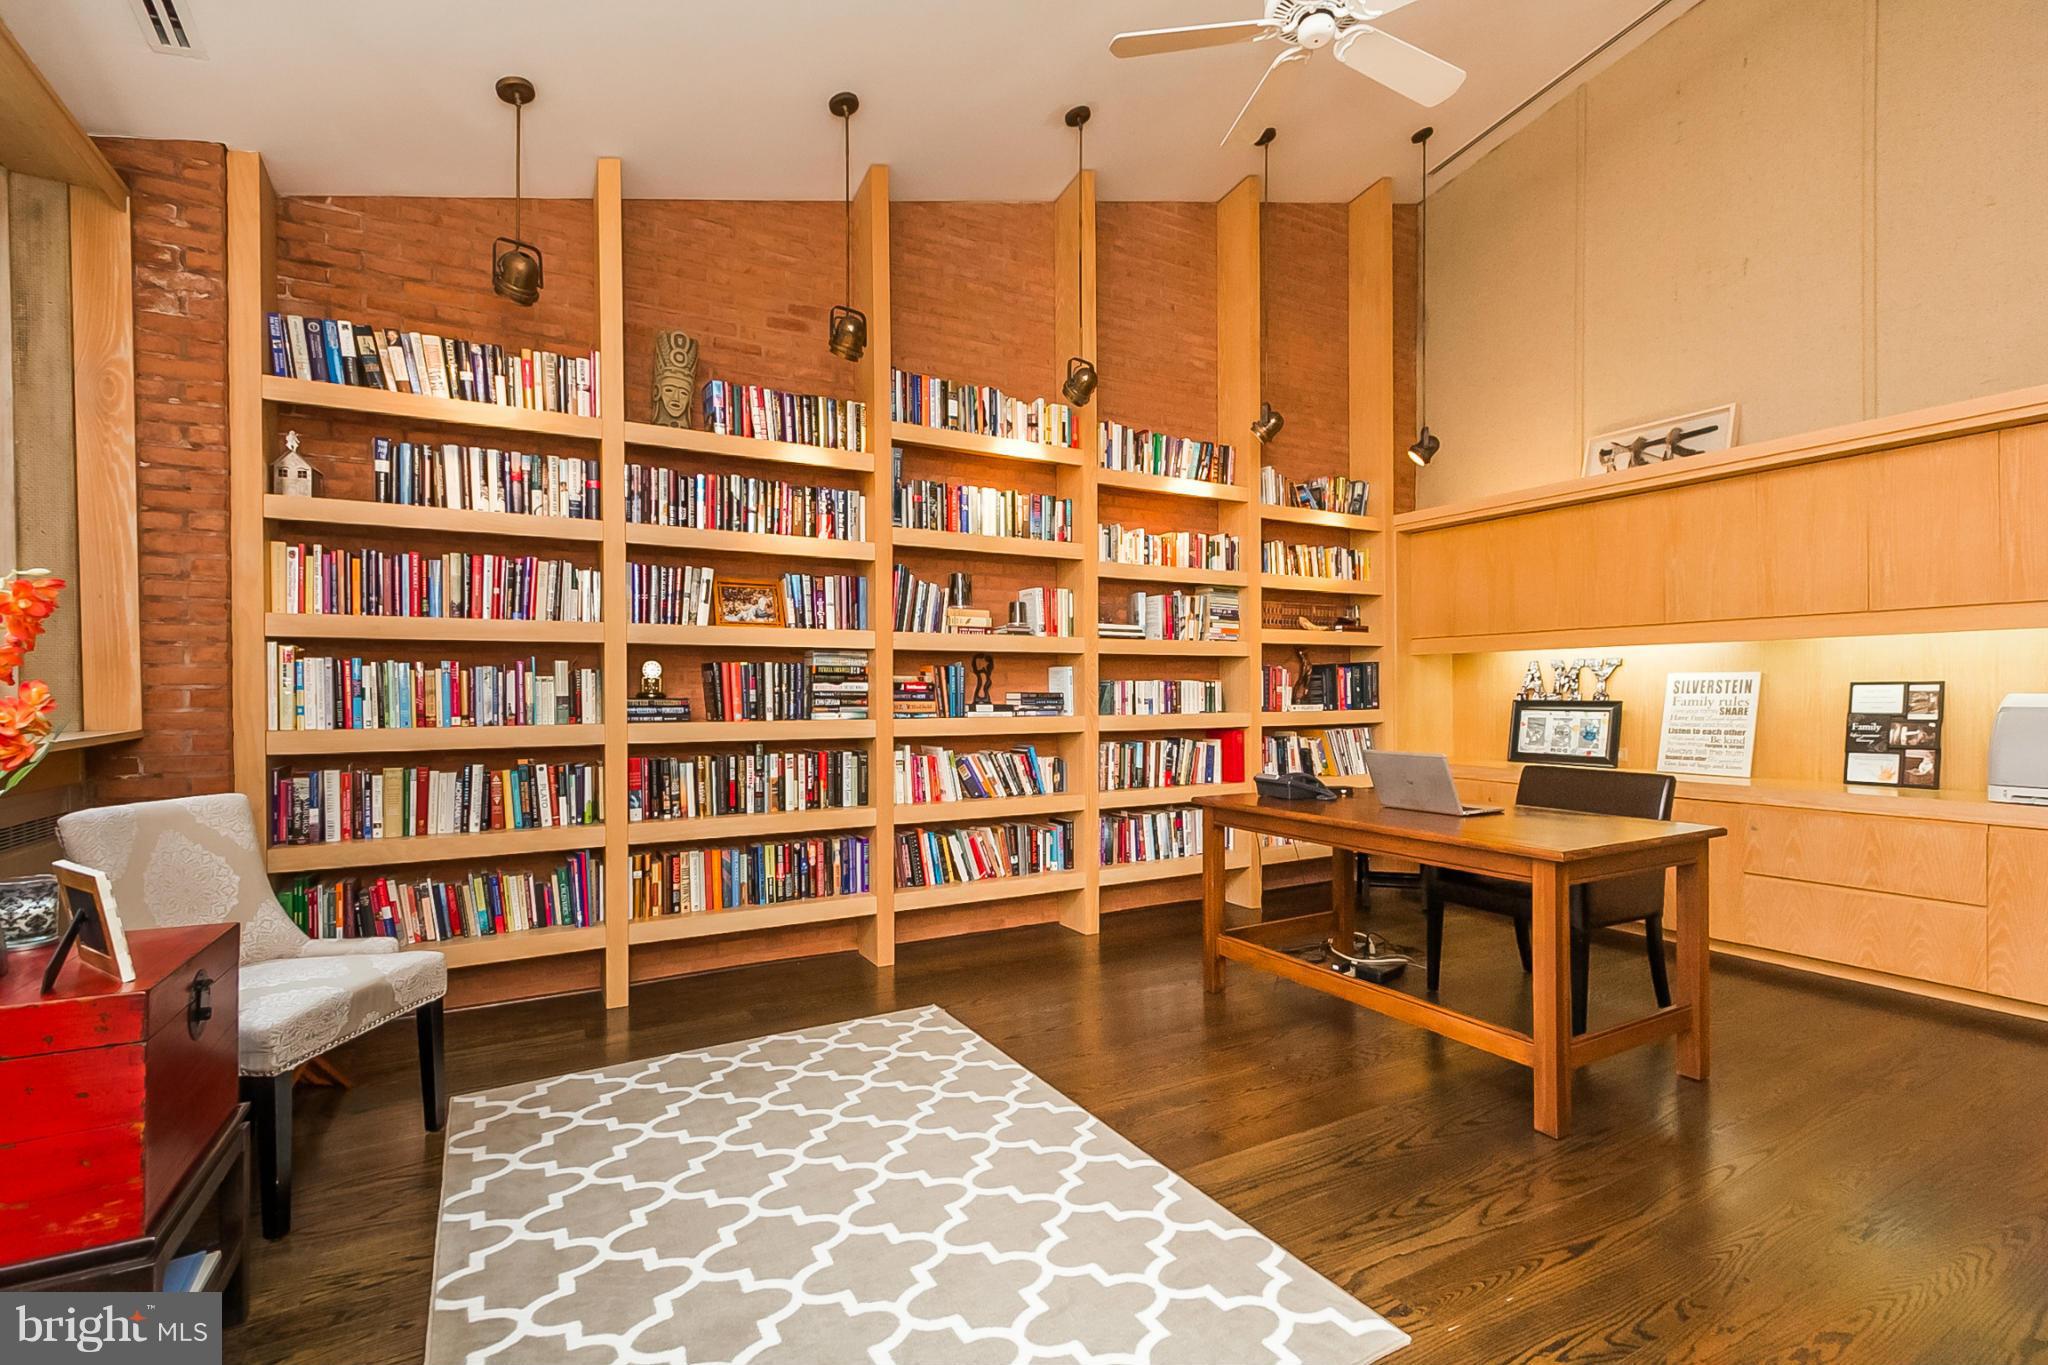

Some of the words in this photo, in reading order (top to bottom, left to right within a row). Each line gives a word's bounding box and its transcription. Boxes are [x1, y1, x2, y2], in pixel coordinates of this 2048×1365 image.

[1516, 657, 1623, 702] AMY
[1672, 679, 1753, 695] SILVERSTEIN
[1671, 696, 1713, 709] Family
[1719, 695, 1750, 707] rules
[1719, 706, 1749, 716] SHARE
[1668, 727, 1691, 735] Listen
[1702, 728, 1722, 736] each
[1723, 728, 1746, 736] other
[1850, 722, 1882, 733] Family
[1710, 735, 1721, 744] Be
[1723, 735, 1746, 745] kind
[539, 783, 549, 809] PLATO
